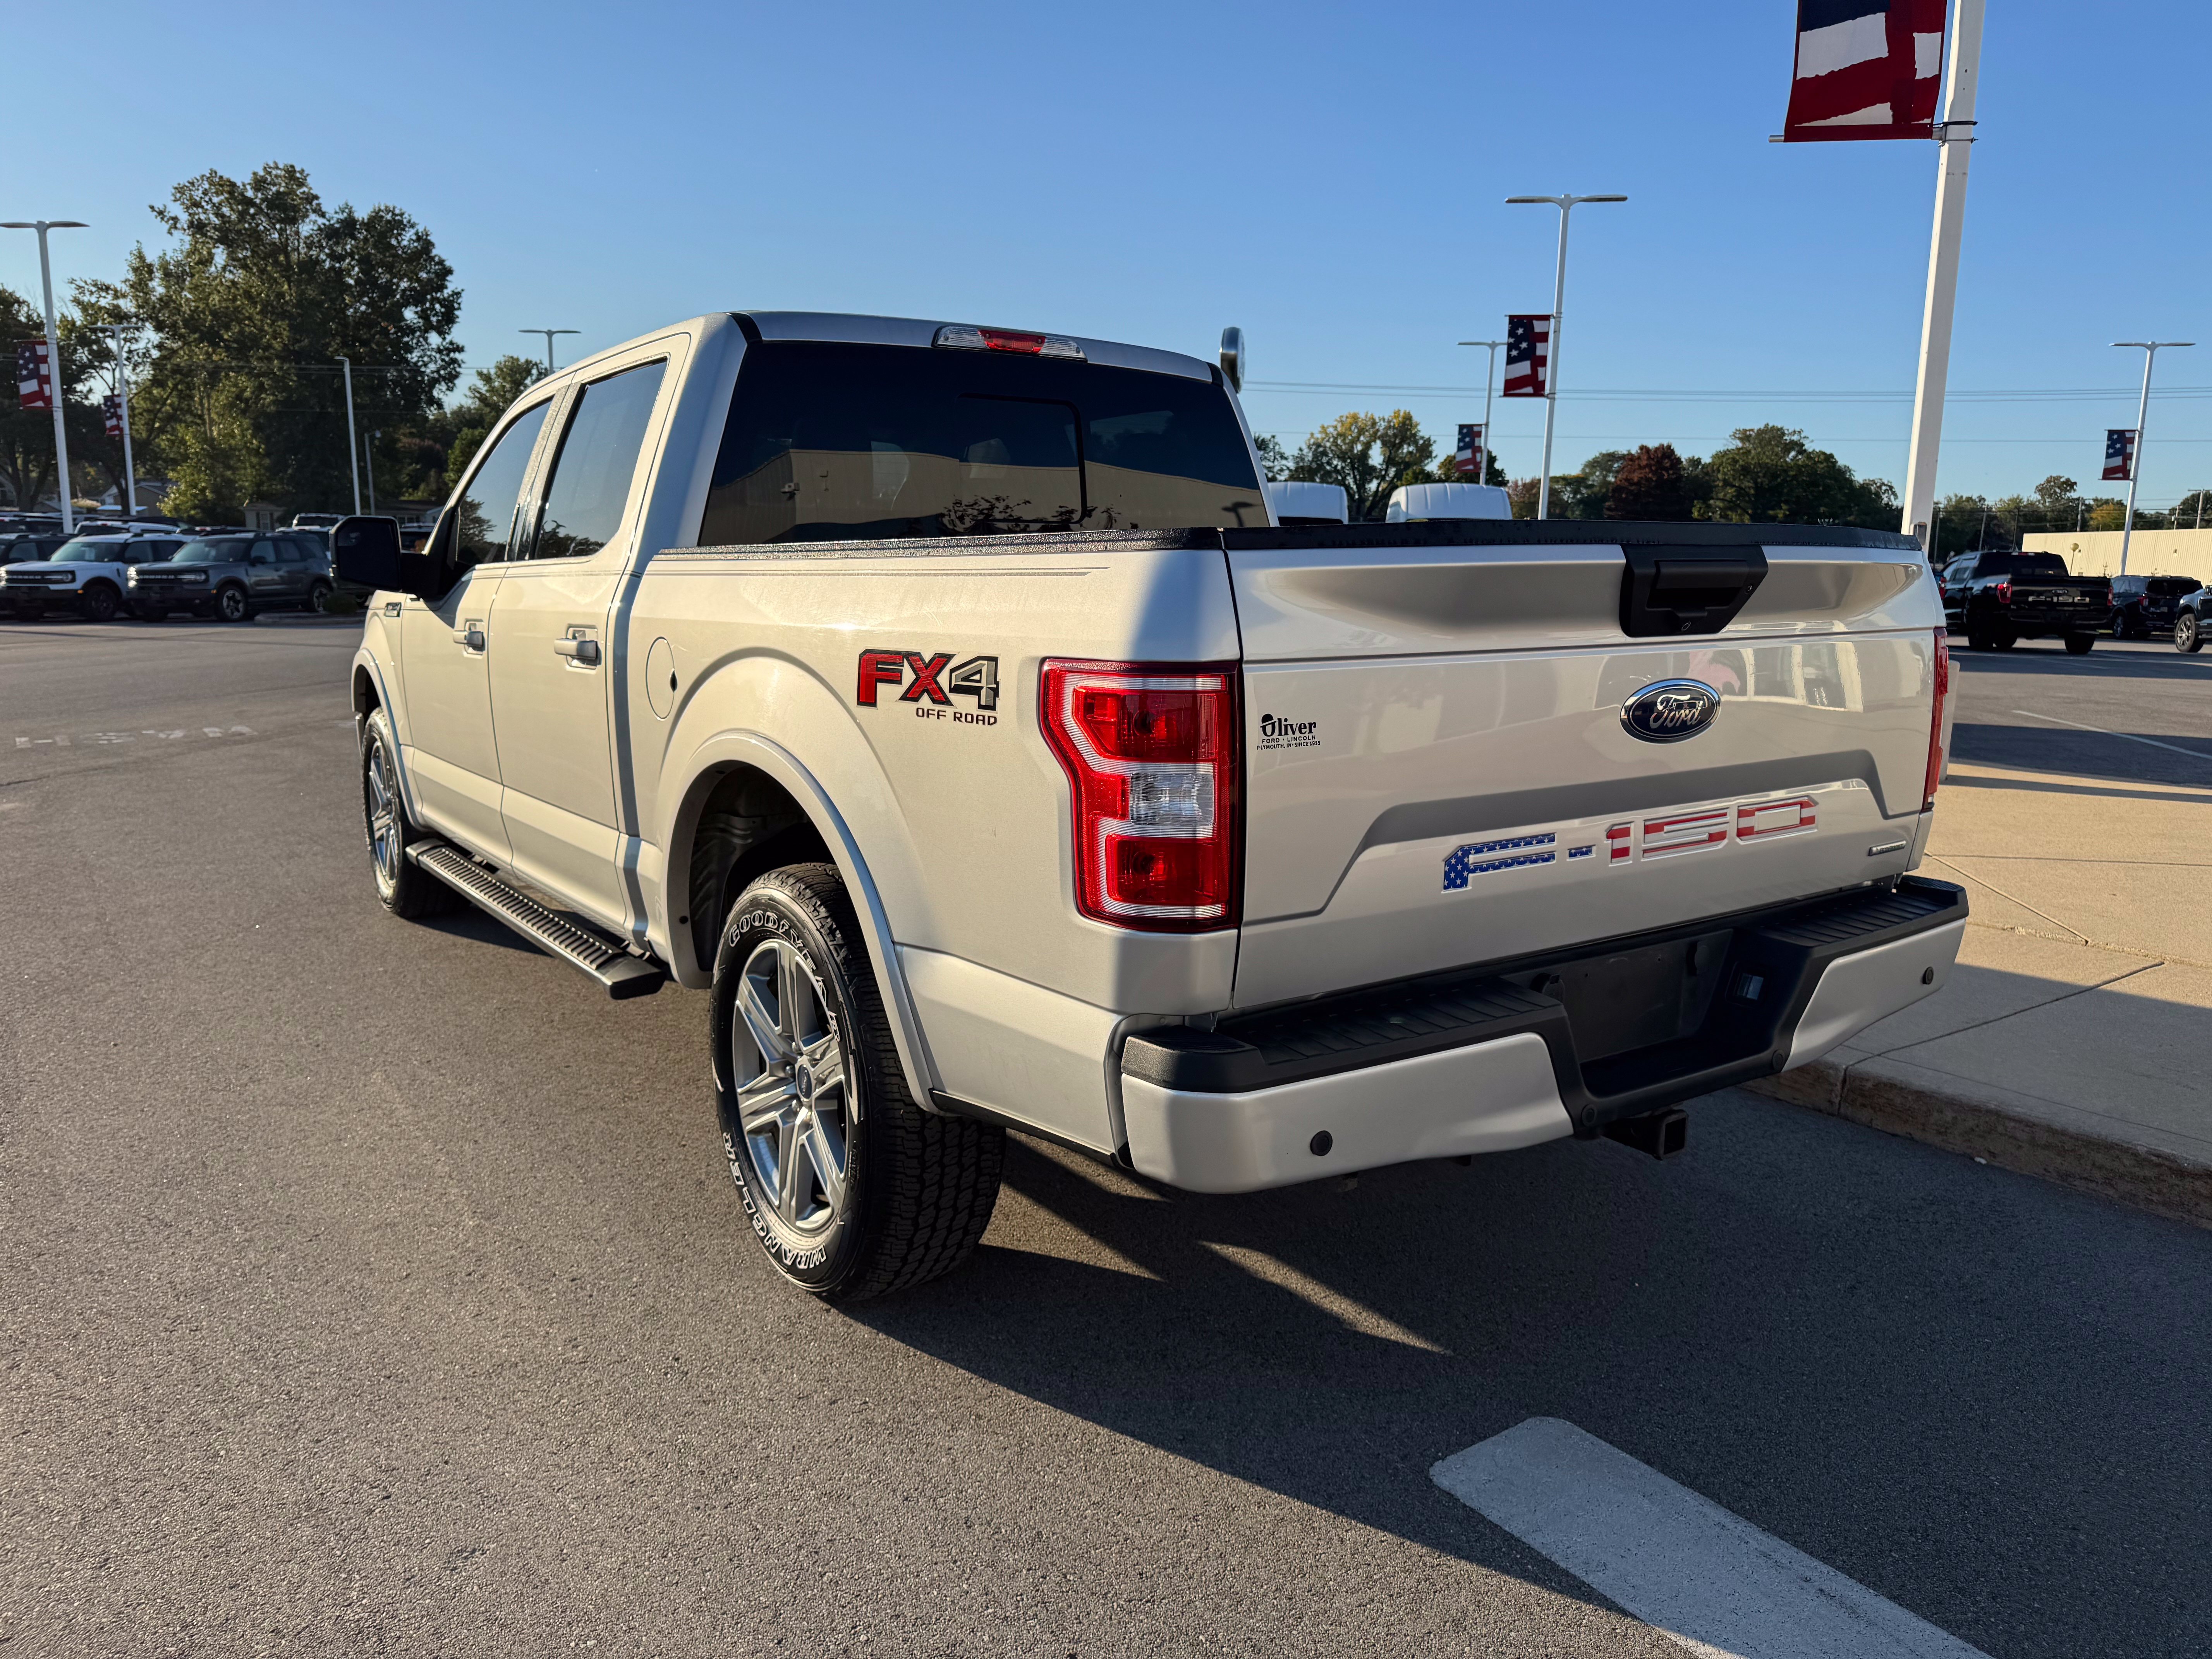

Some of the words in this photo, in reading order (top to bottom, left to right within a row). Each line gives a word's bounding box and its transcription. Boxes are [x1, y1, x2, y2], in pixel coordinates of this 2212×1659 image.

[857, 648, 1000, 712] FX4
[916, 707, 946, 720] OFF
[953, 711, 997, 725] ROAD
[1260, 713, 1317, 737] Oliver
[1441, 795, 1818, 893] F-150
[723, 1132, 826, 1269] WRANGLER
